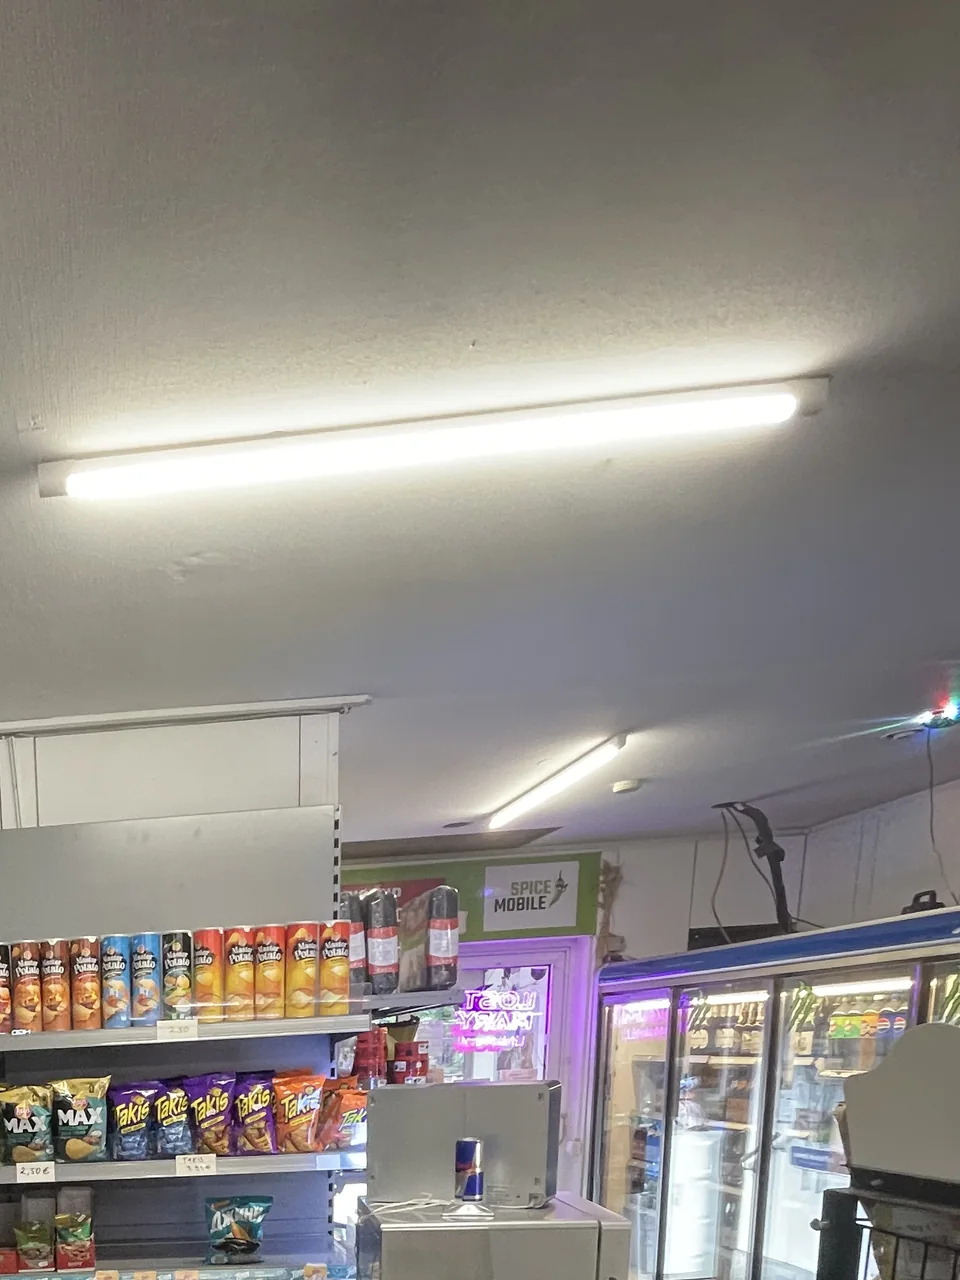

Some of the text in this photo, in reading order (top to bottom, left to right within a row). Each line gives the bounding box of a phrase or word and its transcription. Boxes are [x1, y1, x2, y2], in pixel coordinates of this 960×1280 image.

[510, 880, 552, 896] SPICE
[494, 896, 547, 913] MOBILE
[228, 951, 254, 963] Potato
[255, 950, 282, 962] Potato
[322, 947, 349, 960] Potato
[154, 1095, 190, 1121] Takis
[190, 1090, 229, 1124] Takis
[235, 1088, 272, 1118] Takis
[57, 1108, 103, 1126] MAX
[114, 1099, 150, 1128] Takis
[341, 1109, 367, 1128] Tak
[3, 1116, 48, 1133] MAX
